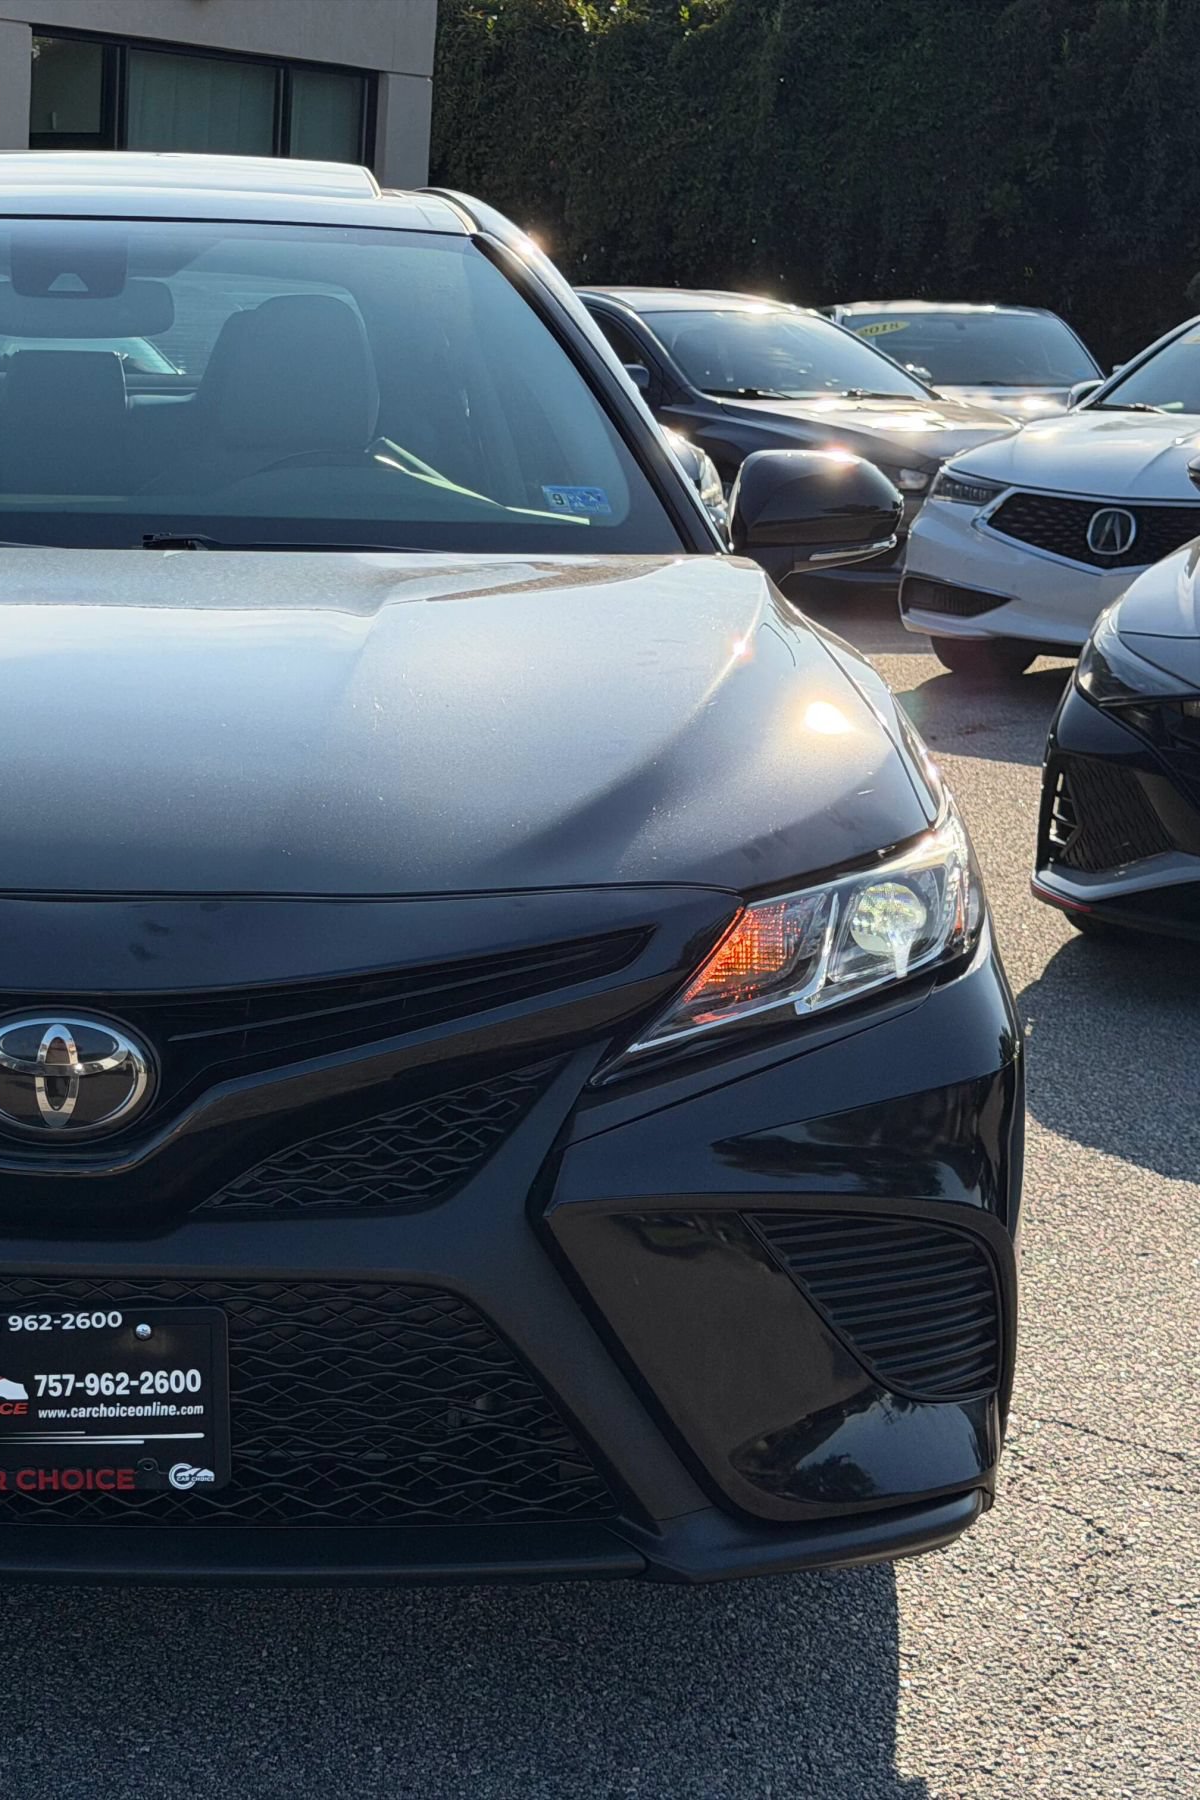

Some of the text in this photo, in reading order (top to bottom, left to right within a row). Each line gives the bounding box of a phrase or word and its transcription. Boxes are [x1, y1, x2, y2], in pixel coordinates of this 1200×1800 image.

[553, 493, 565, 506] 9
[8, 1311, 123, 1332] 962-2600
[34, 1369, 202, 1397] 757-962-2600
[38, 1401, 204, 1419] www.carchoiceonline.com
[16, 1468, 136, 1490] CHOICE
